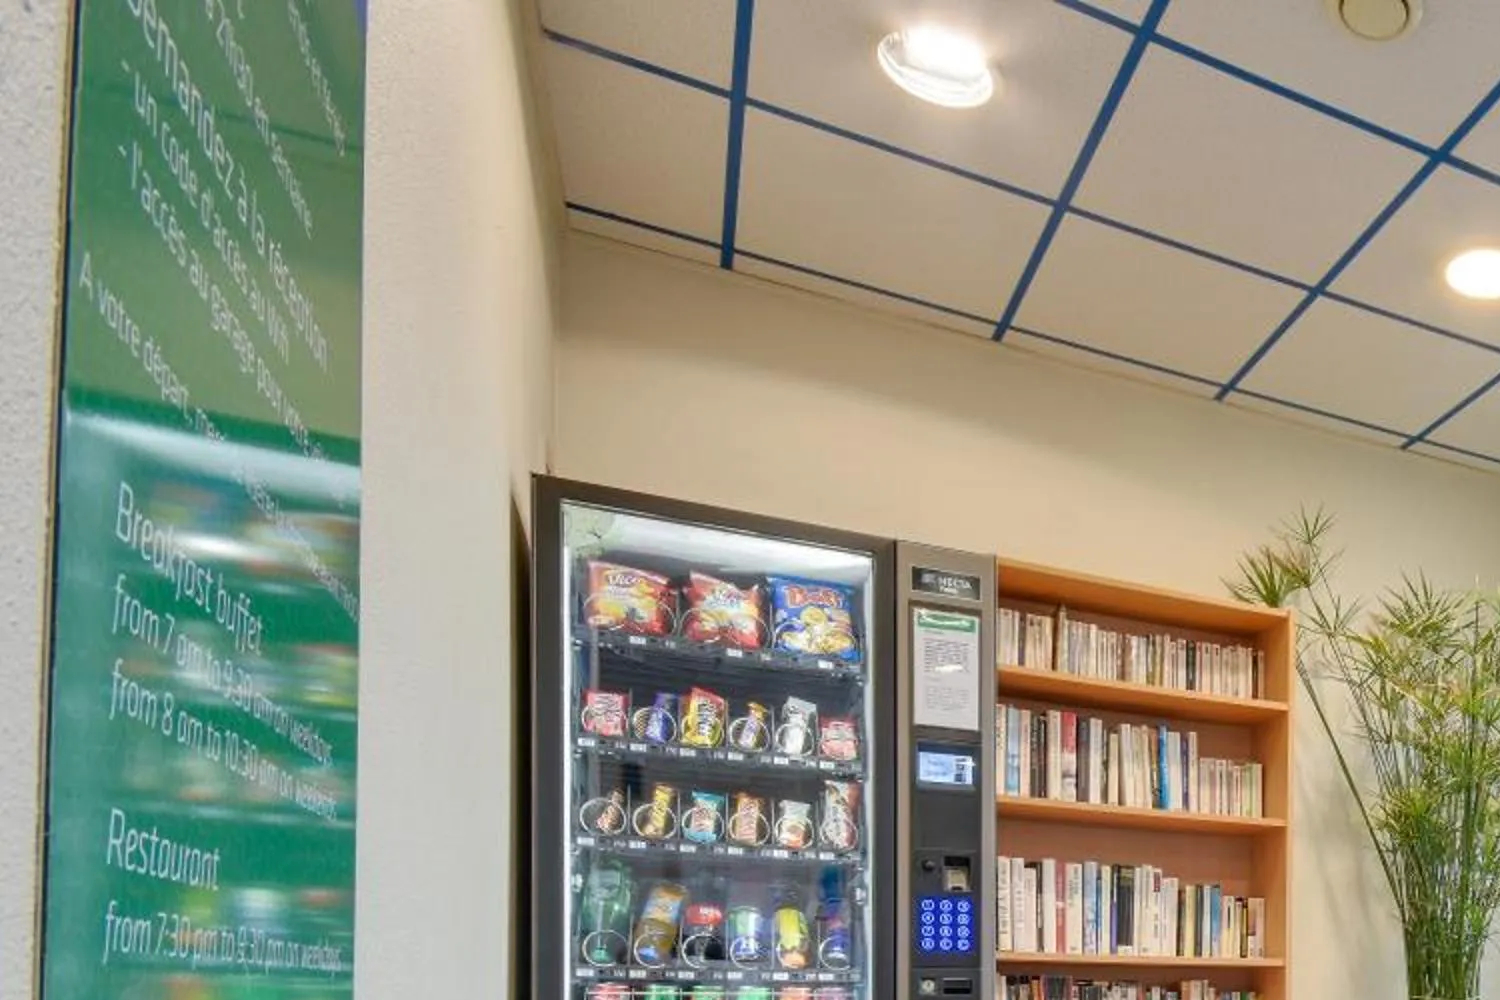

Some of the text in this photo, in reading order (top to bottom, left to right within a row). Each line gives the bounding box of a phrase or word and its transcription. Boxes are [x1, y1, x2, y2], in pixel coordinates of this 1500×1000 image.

[130, 0, 235, 200] emandez
[251, 194, 265, 256] la
[269, 234, 328, 372] réception
[134, 73, 157, 137] un
[161, 121, 198, 208] code
[79, 252, 93, 299] A
[98, 283, 140, 357] votre
[190, 256, 208, 300] au
[211, 283, 255, 375] garage
[115, 482, 213, 613] Breakfast
[216, 574, 262, 656] buffet
[112, 574, 159, 646] from
[163, 614, 174, 657] 7
[176, 635, 205, 675] am
[207, 653, 221, 691] to
[109, 659, 157, 727] from
[163, 694, 174, 735] 8
[177, 713, 203, 750] am
[206, 724, 221, 762] to
[225, 731, 258, 781] 10:30
[107, 808, 220, 888] Restaurant
[103, 901, 152, 962] from
[155, 913, 190, 957] 7:30
[193, 926, 219, 967] pm
[221, 926, 234, 959] to
